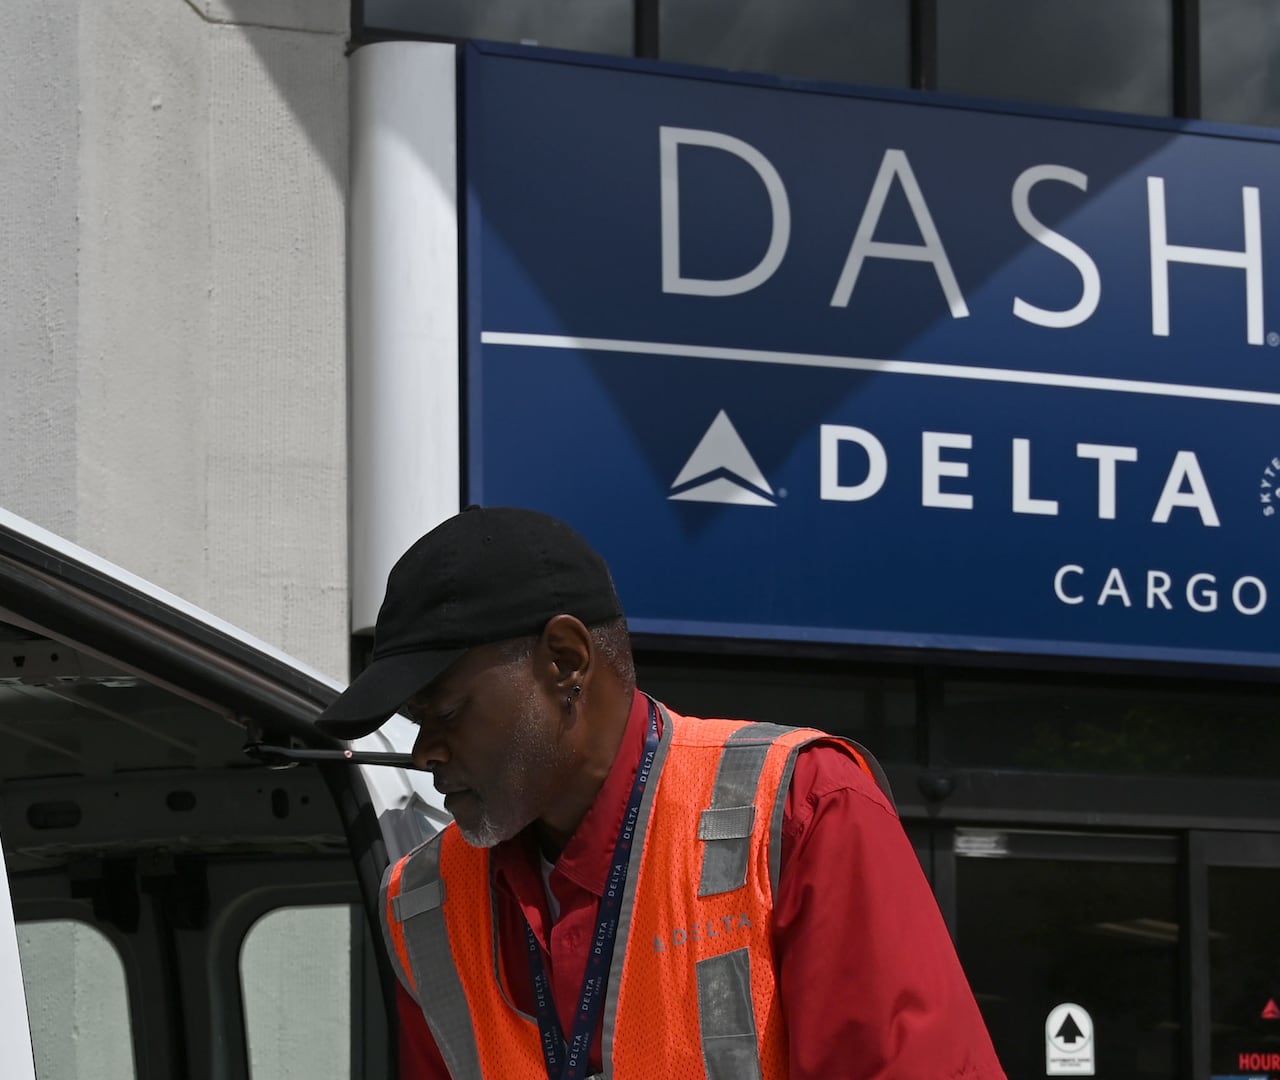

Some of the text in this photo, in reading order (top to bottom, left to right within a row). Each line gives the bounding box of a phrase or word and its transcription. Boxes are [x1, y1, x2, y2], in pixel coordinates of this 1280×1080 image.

[819, 423, 1221, 528] DELTA
[1054, 563, 1267, 616] CARGO
[640, 751, 654, 782] DELTA
[623, 806, 638, 839] DELTA
[608, 864, 622, 897] DELTA
[595, 921, 607, 955] DELTA
[672, 912, 752, 947] DELTA
[535, 975, 545, 1007] DELTA
[582, 978, 594, 1011] DELTA
[545, 1031, 556, 1064] DELTA
[569, 1034, 582, 1067] DELTA
